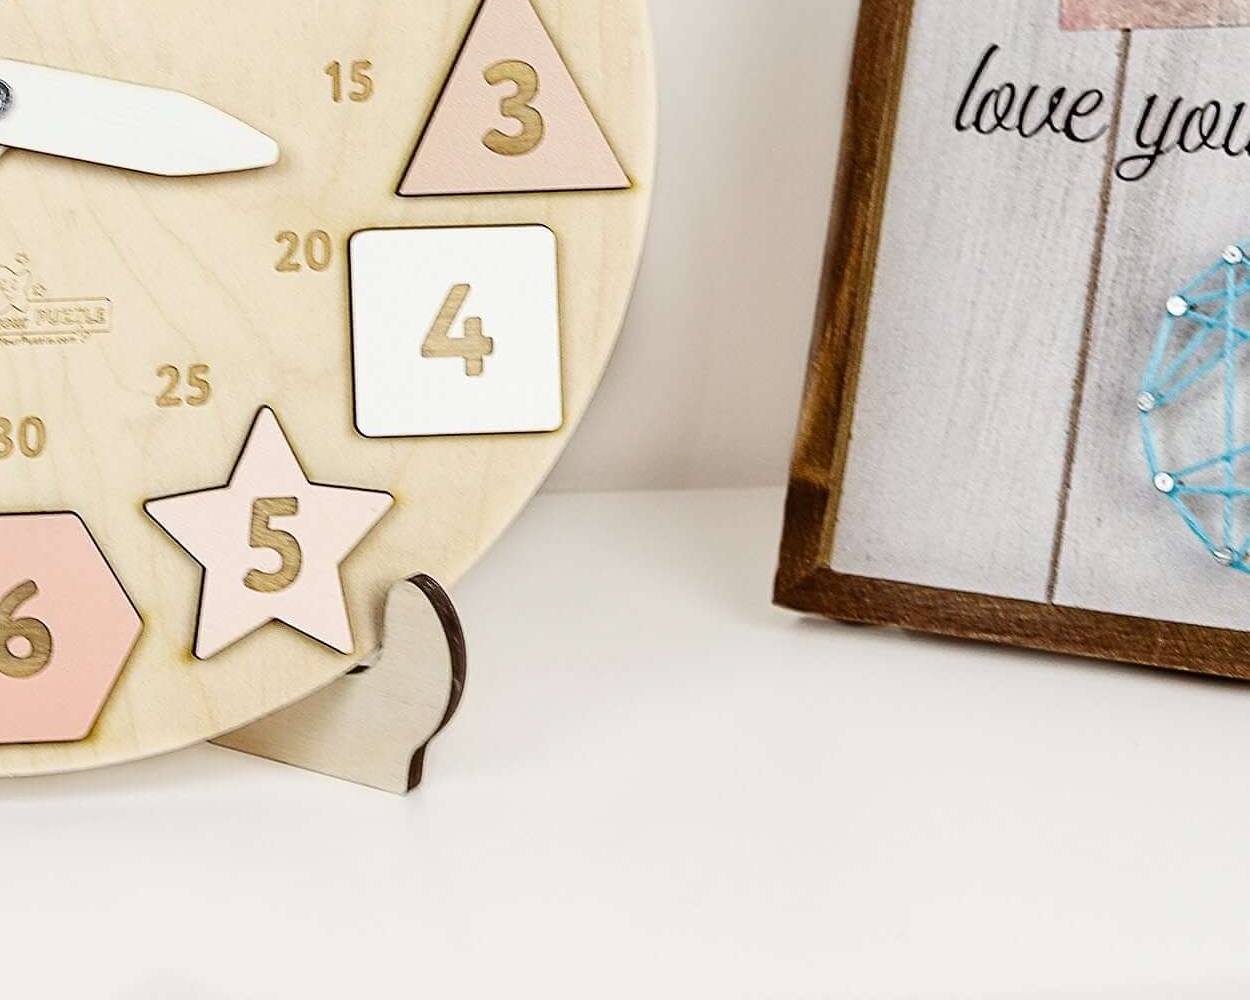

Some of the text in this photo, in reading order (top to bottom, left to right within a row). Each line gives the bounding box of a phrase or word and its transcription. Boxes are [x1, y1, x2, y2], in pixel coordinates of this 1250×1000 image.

[325, 59, 373, 103] 15
[482, 59, 545, 157] 3
[954, 44, 1108, 143] love
[275, 230, 333, 272] 20
[34, 306, 105, 326] PUZZLE
[420, 283, 494, 377] 4
[156, 364, 212, 407] 25
[242, 496, 303, 593] 5
